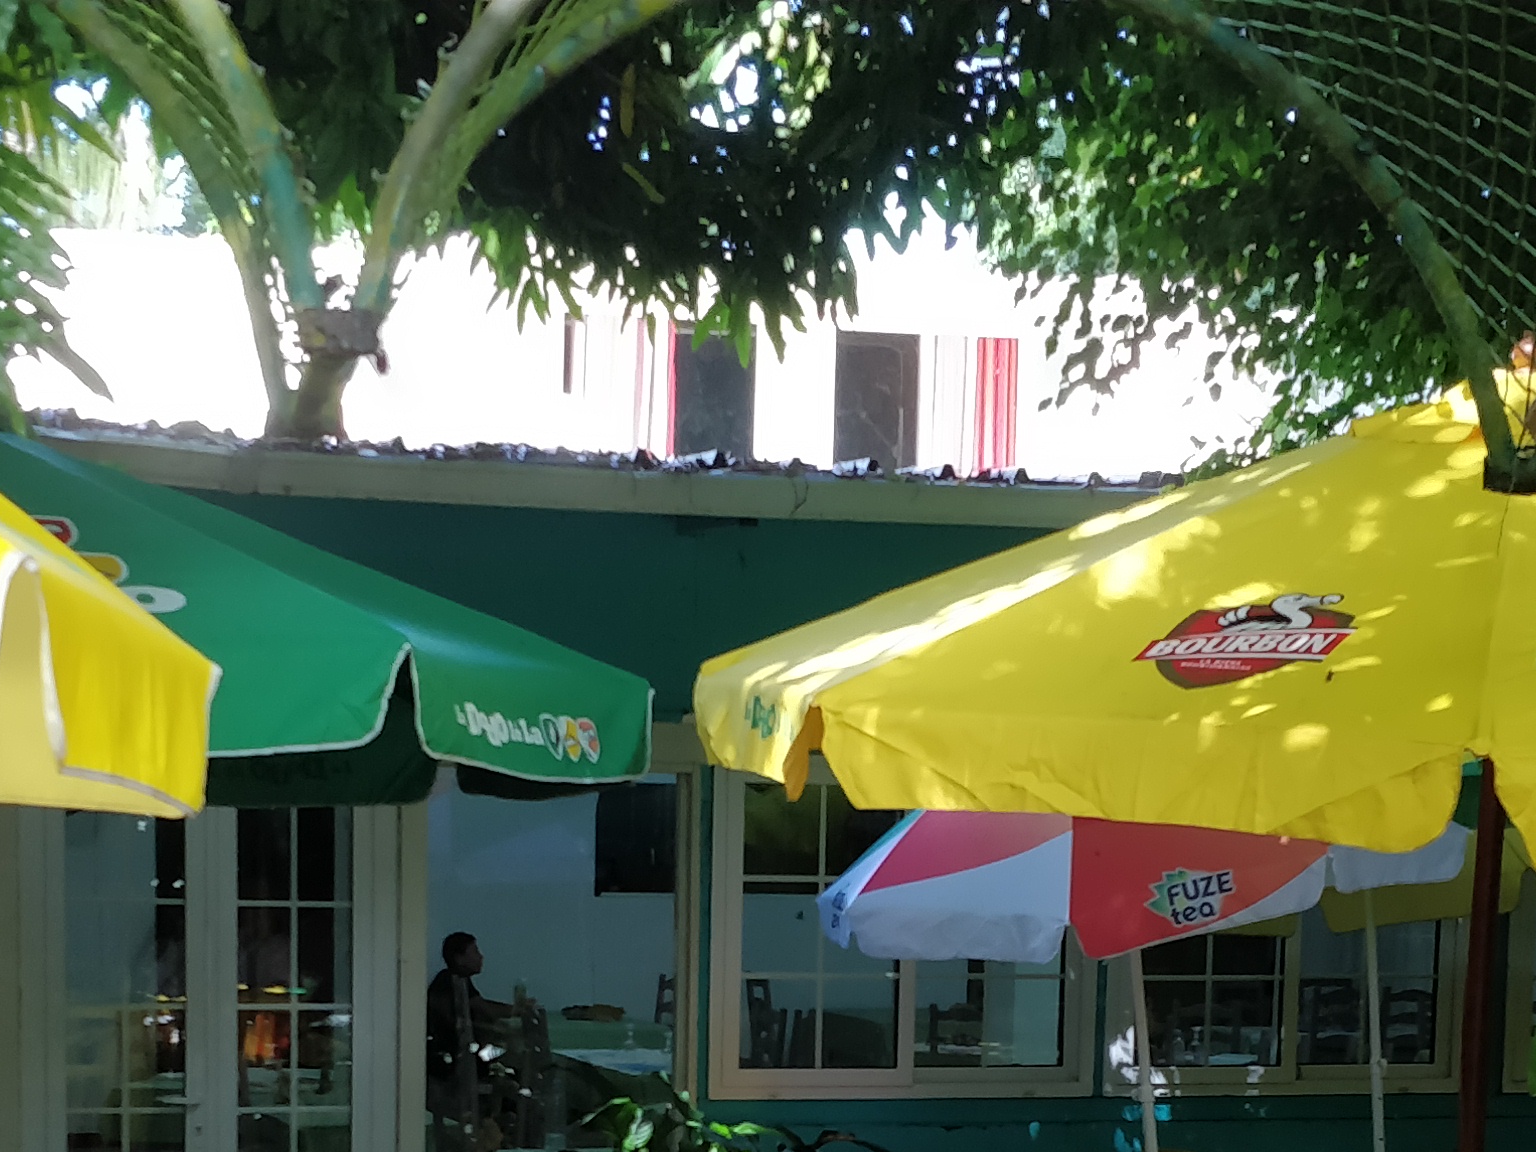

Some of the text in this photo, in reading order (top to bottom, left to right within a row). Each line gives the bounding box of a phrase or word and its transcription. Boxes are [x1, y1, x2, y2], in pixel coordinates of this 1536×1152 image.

[1144, 633, 1338, 657] BOURBON
[1167, 871, 1233, 906] FUZE
[1171, 901, 1216, 925] tea
